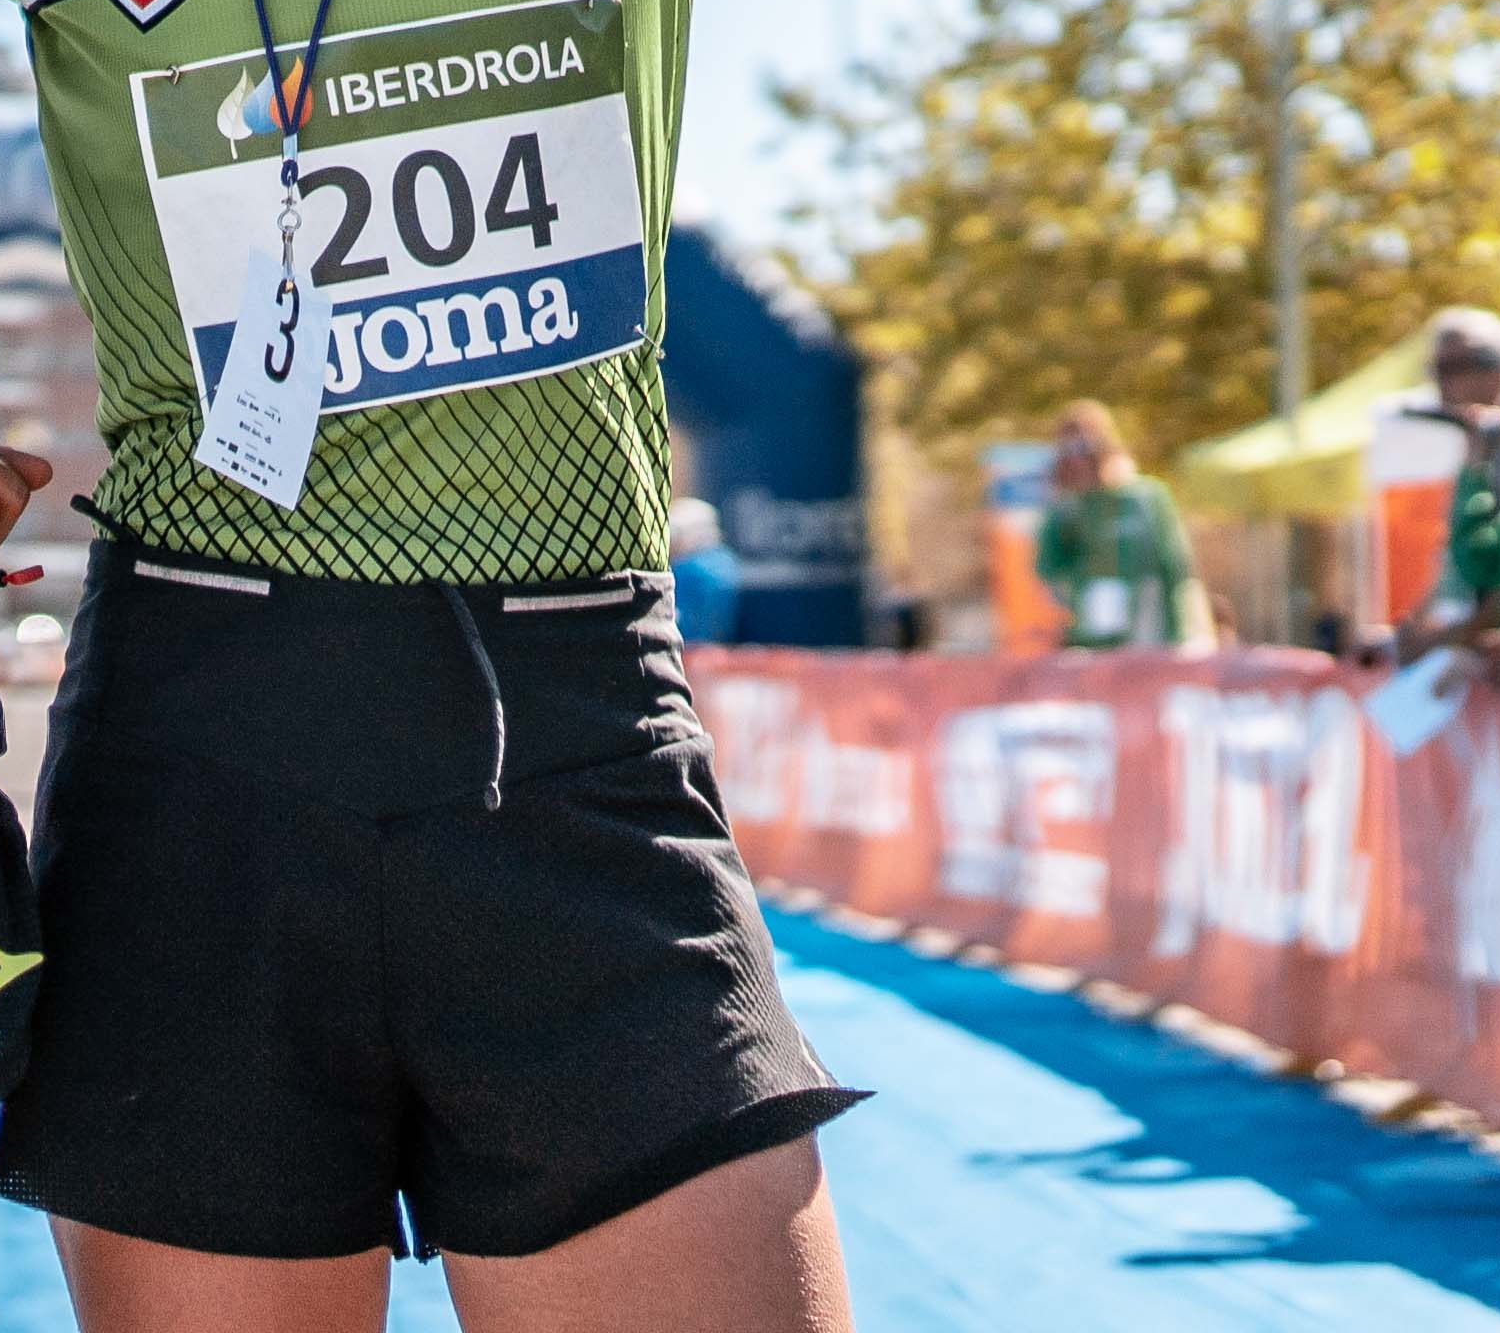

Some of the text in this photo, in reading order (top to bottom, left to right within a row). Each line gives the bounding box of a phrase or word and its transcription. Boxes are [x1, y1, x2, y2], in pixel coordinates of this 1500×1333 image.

[325, 35, 586, 118] IBERDROLA
[297, 131, 559, 289] 204
[264, 278, 301, 384] 3
[324, 276, 579, 395] Joma
